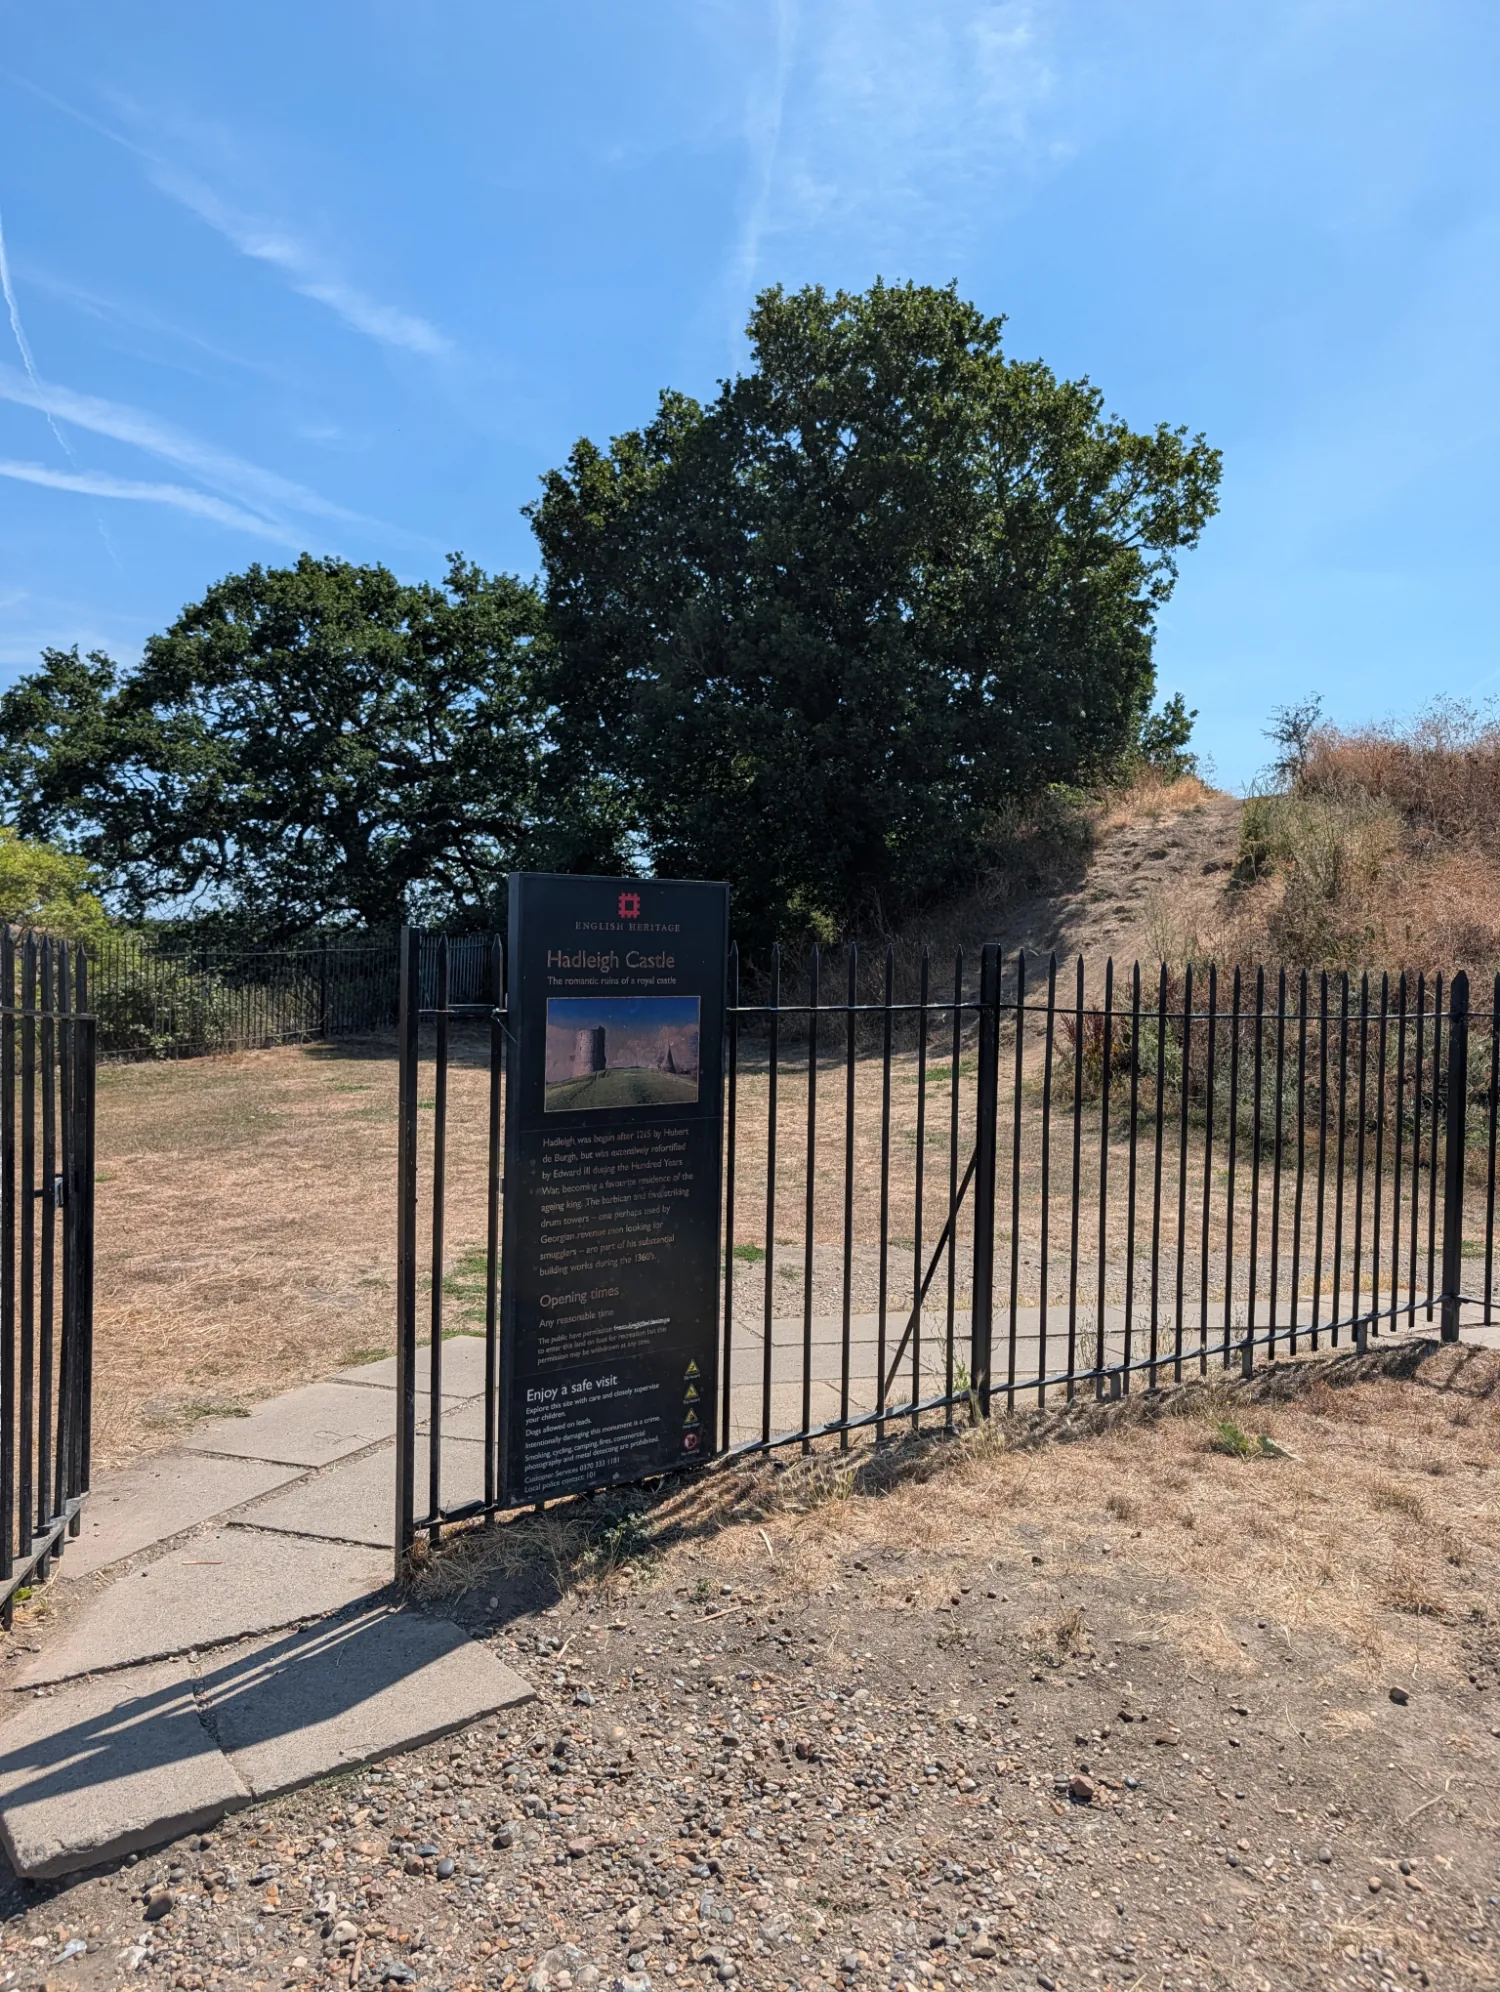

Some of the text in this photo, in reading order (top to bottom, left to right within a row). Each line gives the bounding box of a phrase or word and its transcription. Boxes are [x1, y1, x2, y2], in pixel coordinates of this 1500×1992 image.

[575, 922, 680, 932] ENGLISH HERITAGE
[548, 950, 675, 973] Hadleigh Castle
[637, 977, 654, 986] royal
[543, 1137, 575, 1147] Hadleigh
[594, 1135, 614, 1144] begun
[636, 1131, 651, 1139] 1215
[653, 1130, 661, 1139] by
[543, 1155, 552, 1163] de
[555, 1153, 578, 1163] Burgh,
[581, 1151, 592, 1159] but
[611, 1147, 649, 1156] extensively
[651, 1143, 686, 1152] refortified
[542, 1172, 551, 1181] by
[554, 1169, 581, 1178] Edward
[593, 1165, 615, 1174] during
[617, 1163, 628, 1171] the
[632, 1159, 661, 1169] Hundred
[664, 1159, 682, 1167] Years
[562, 1183, 597, 1193] becoming
[605, 1179, 636, 1188] favourite
[638, 1175, 670, 1184] residence
[673, 1173, 681, 1181] of
[682, 1172, 693, 1180] the
[541, 1203, 564, 1213] ageing
[602, 1195, 631, 1204] barbican
[634, 1192, 646, 1200] and
[664, 1188, 689, 1197] striking
[541, 1218, 561, 1228] drum
[564, 1215, 589, 1225] towers
[614, 1209, 641, 1221] perhaps
[662, 1206, 670, 1214] by
[541, 1234, 574, 1243] Georgian
[577, 1230, 605, 1239] revenue
[626, 1223, 651, 1232] looking
[540, 1249, 576, 1260] smugglers
[638, 1234, 674, 1245] substantial
[540, 1265, 568, 1276] building
[571, 1262, 593, 1271] works
[595, 1259, 618, 1268] during
[540, 1287, 619, 1309] Opening times
[539, 1309, 614, 1328] Any reasonable time
[551, 1335, 567, 1344] public
[583, 1327, 612, 1338] permission
[618, 1330, 645, 1339] recreation
[538, 1354, 568, 1365] permission
[591, 1344, 619, 1354] withdrawn
[527, 1375, 617, 1402] Enjoy a safe visit
[526, 1405, 549, 1415] Explore
[614, 1388, 632, 1397] closely
[634, 1383, 659, 1393] supervise
[526, 1412, 565, 1425] your children.
[543, 1424, 565, 1433] allowed
[525, 1436, 561, 1448] Intentionally
[563, 1431, 589, 1441] damaging
[602, 1422, 632, 1432] monument
[614, 1430, 645, 1441] commercial
[525, 1458, 562, 1472] photography
[575, 1452, 591, 1460] metal
[593, 1446, 619, 1455] detecting
[525, 1474, 553, 1483] Customer
[556, 1468, 578, 1478] Services
[580, 1463, 594, 1471] 0370
[524, 1484, 540, 1493] Local
[543, 1480, 560, 1490] police
